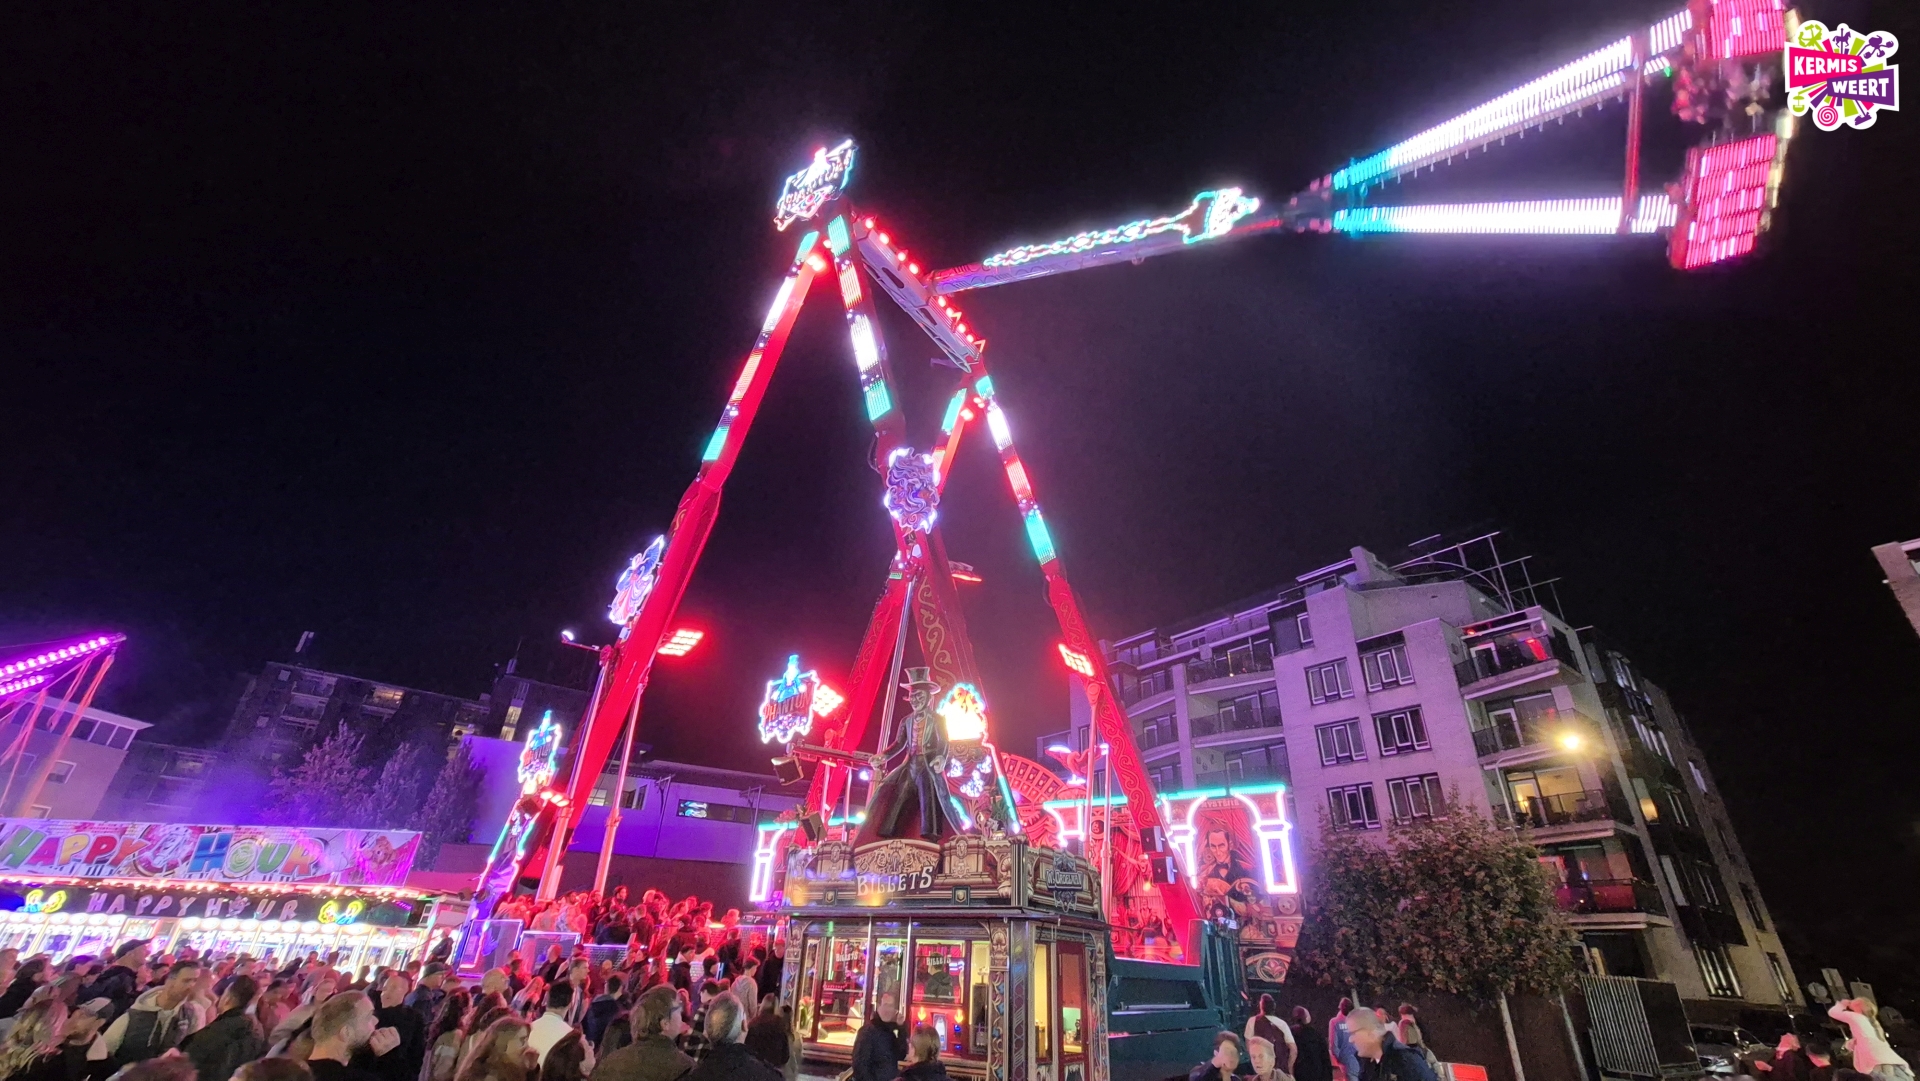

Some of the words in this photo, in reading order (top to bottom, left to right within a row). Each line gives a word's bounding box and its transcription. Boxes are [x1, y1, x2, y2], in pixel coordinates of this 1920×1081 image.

[0, 826, 147, 868] HAPPY
[187, 832, 324, 878] HOUR
[857, 866, 933, 896] BILLETS
[86, 892, 196, 916] HAPPY
